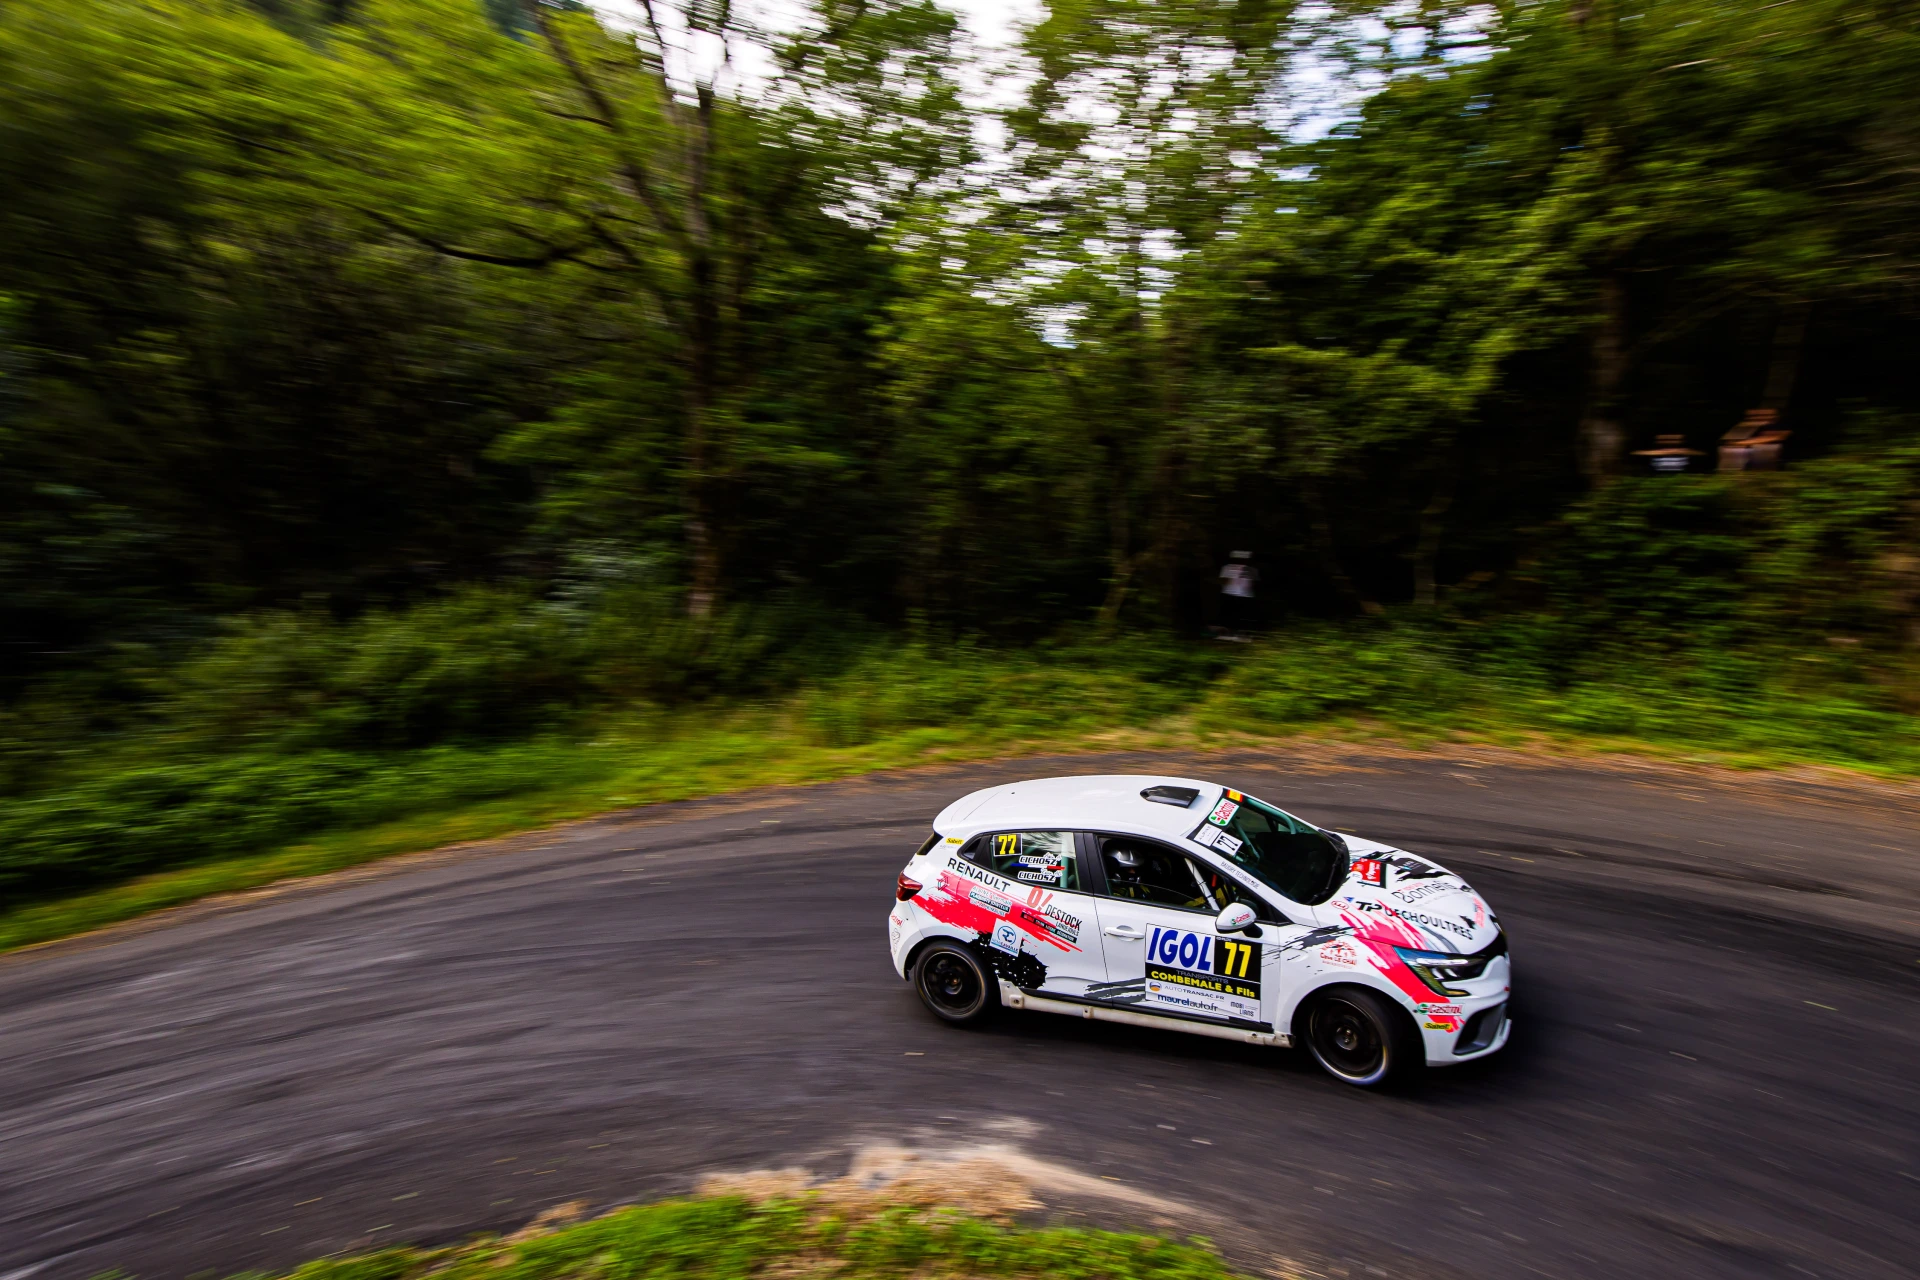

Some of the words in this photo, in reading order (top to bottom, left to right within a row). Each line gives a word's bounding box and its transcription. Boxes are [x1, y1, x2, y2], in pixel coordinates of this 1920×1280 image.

[1214, 800, 1237, 821] Castrol
[998, 834, 1017, 855] 77
[1216, 835, 1239, 851] 77
[1019, 856, 1057, 866] CICHOSZ
[947, 857, 1011, 893] RENAULT
[1018, 872, 1056, 882] CICHOSZ
[1356, 901, 1383, 912] TP
[1044, 904, 1083, 931] DESTOCK
[1147, 927, 1212, 972] IGOL
[1224, 941, 1252, 978] 77
[1151, 970, 1222, 991] COMBEMALE
[1225, 984, 1233, 993] &
[1236, 986, 1256, 998] Fils
[1176, 969, 1229, 985] TRANSPORTS
[1164, 985, 1225, 1000] AUTOTRANSAC.FR
[1157, 994, 1218, 1012] maurelauto.fr
[1429, 1004, 1463, 1014] Castrol
